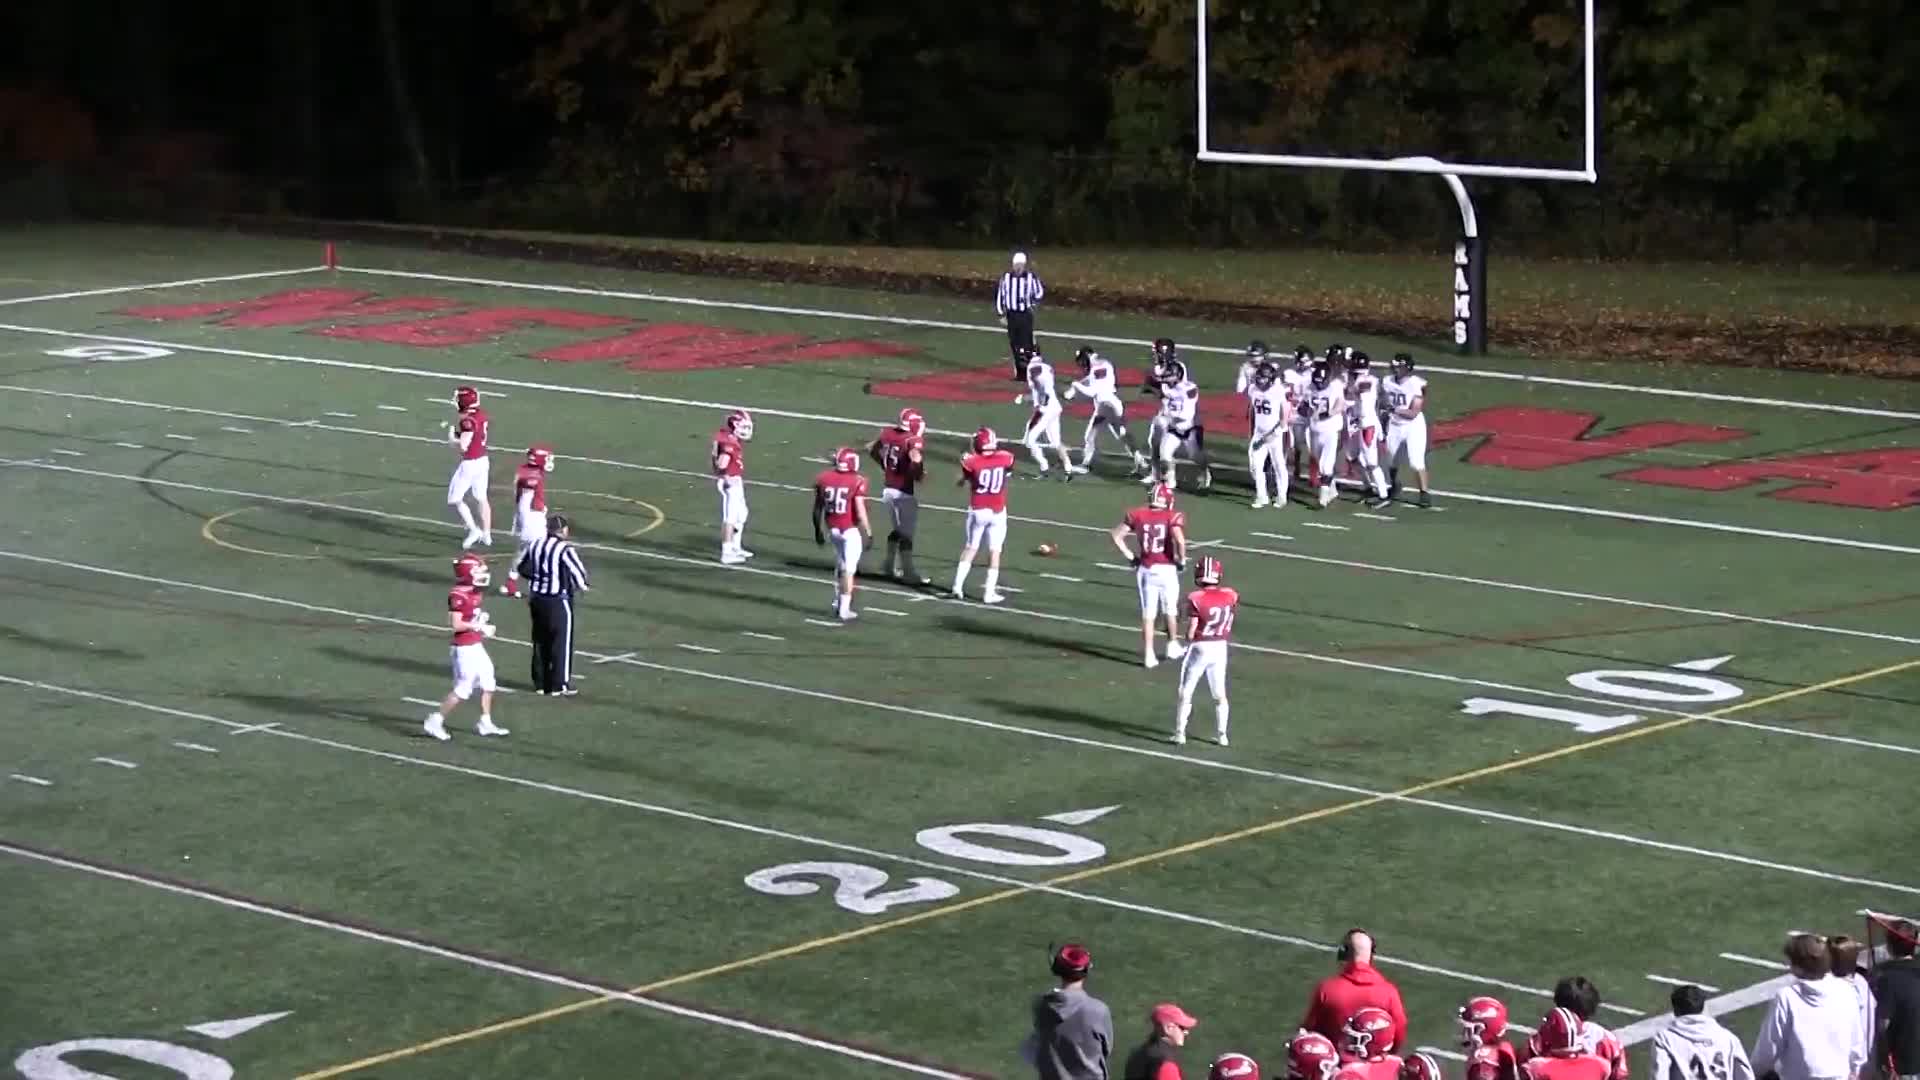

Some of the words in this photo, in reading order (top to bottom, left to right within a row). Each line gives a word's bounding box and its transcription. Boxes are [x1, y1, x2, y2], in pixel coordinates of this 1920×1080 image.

[118, 286, 924, 373] NEW
[1454, 241, 1471, 345] RAMS
[976, 469, 1004, 494] 90
[1142, 523, 1167, 553] 12
[1460, 669, 1744, 733] 10
[744, 823, 1106, 915] 20
